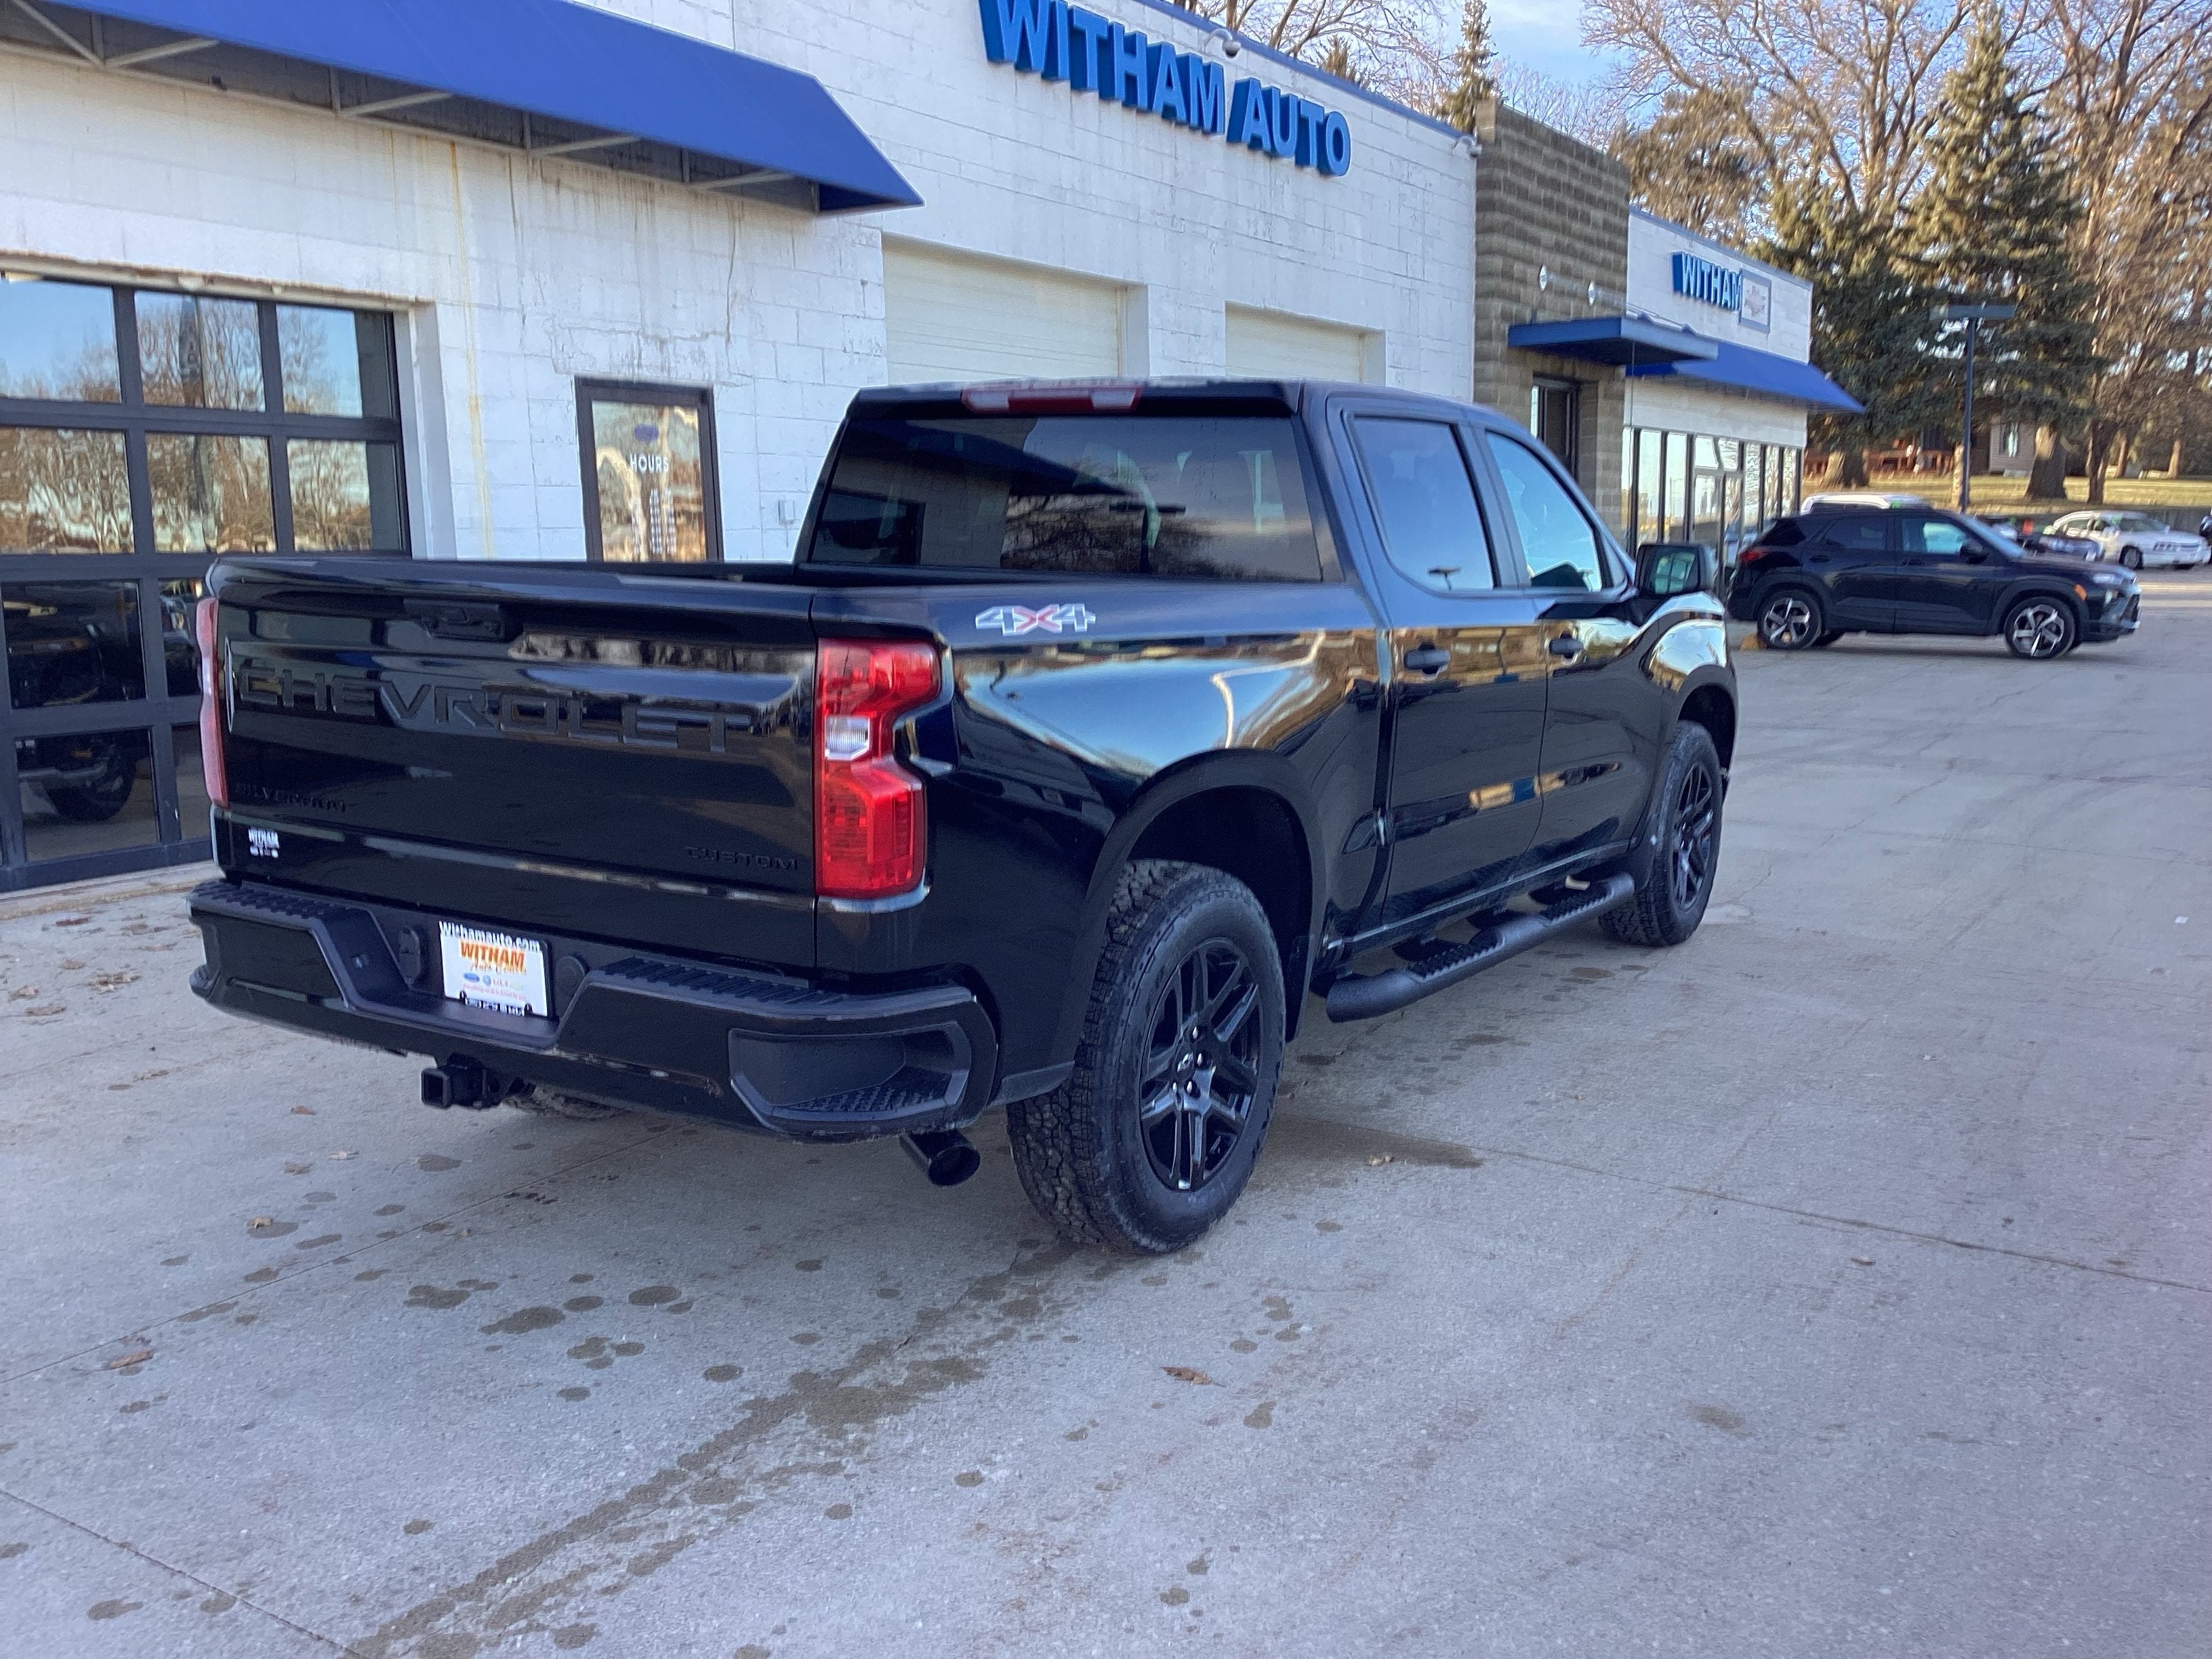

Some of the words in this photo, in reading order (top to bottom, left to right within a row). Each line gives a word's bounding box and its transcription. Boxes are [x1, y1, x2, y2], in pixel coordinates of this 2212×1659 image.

[978, 0, 1225, 135] WITHAM
[1227, 77, 1351, 177] AUTO
[1673, 251, 1742, 312] WITHAM
[629, 453, 669, 472] HOURS
[240, 659, 752, 754] CHEVROLET
[685, 846, 799, 871] CUSTOM
[460, 941, 526, 972] WITHAM
